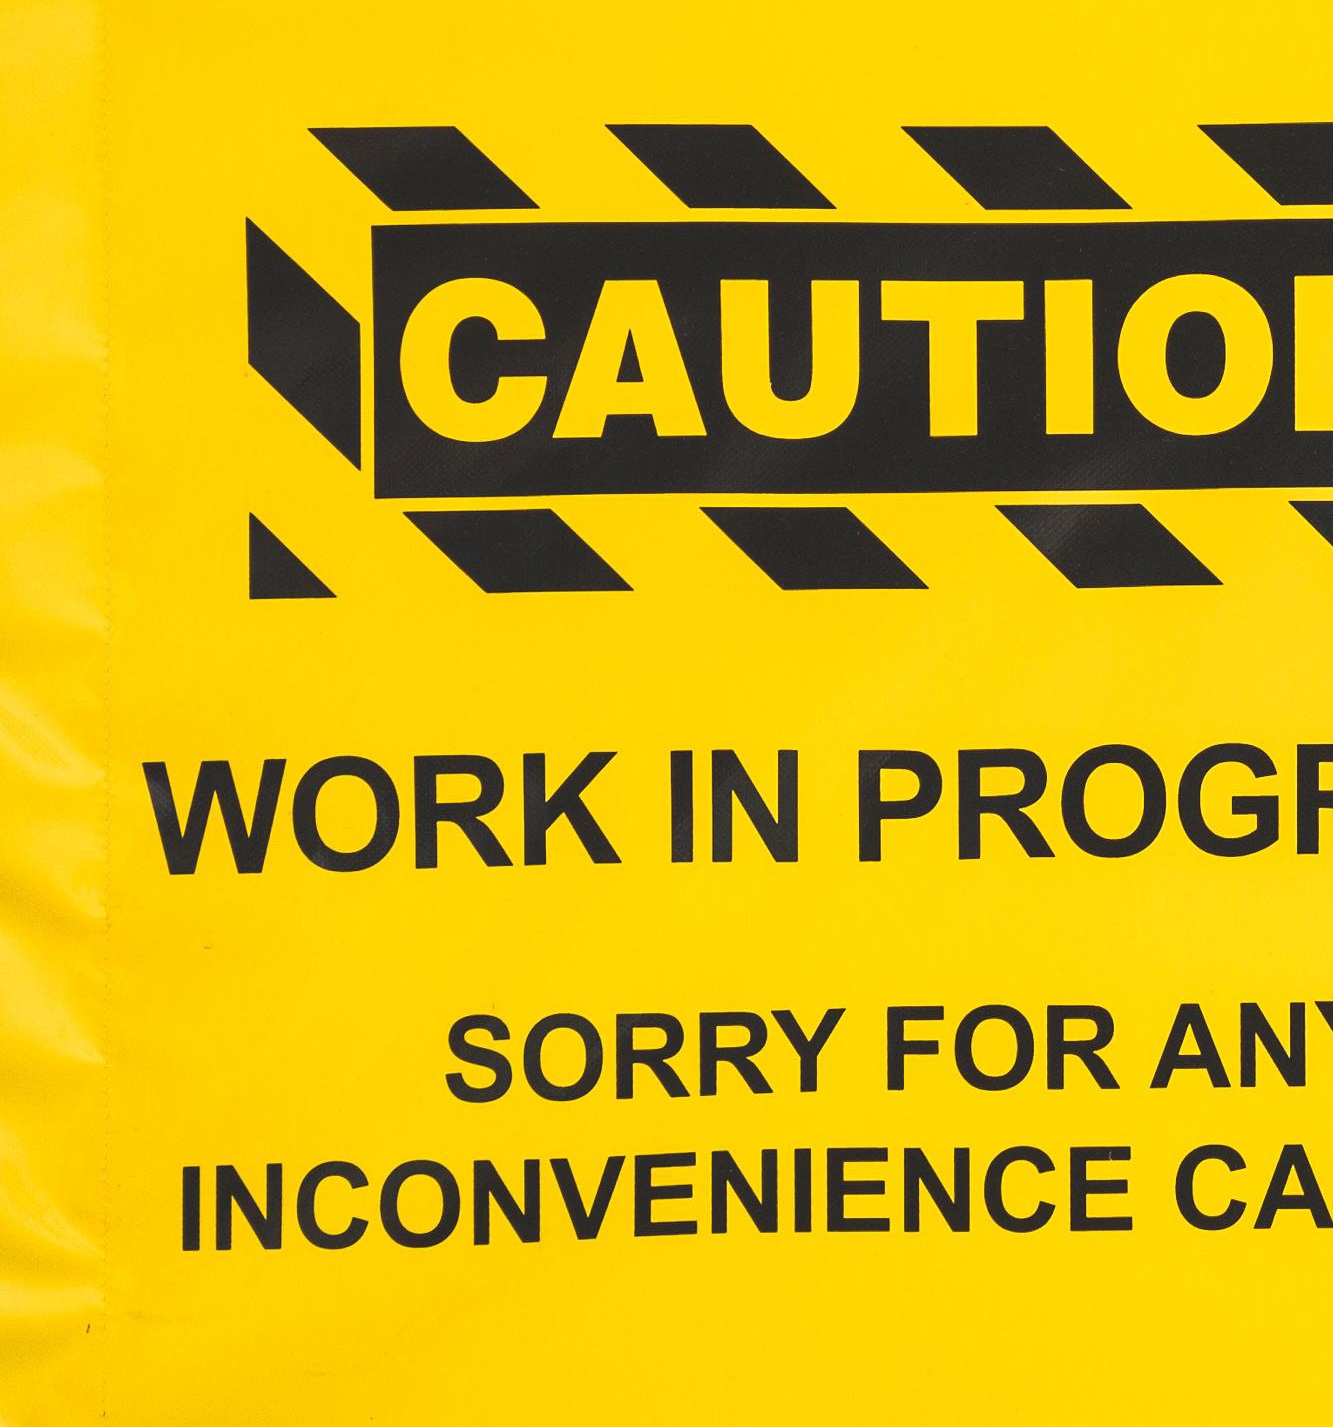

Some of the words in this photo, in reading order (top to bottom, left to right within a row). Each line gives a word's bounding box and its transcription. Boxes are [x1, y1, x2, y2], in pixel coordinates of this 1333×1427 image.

[142, 752, 621, 874] WORK
[671, 750, 798, 862] IN
[446, 1008, 846, 1103] SORRY
[887, 1005, 1120, 1091] FOR
[183, 1146, 1132, 1251] INCONVENIENCE
